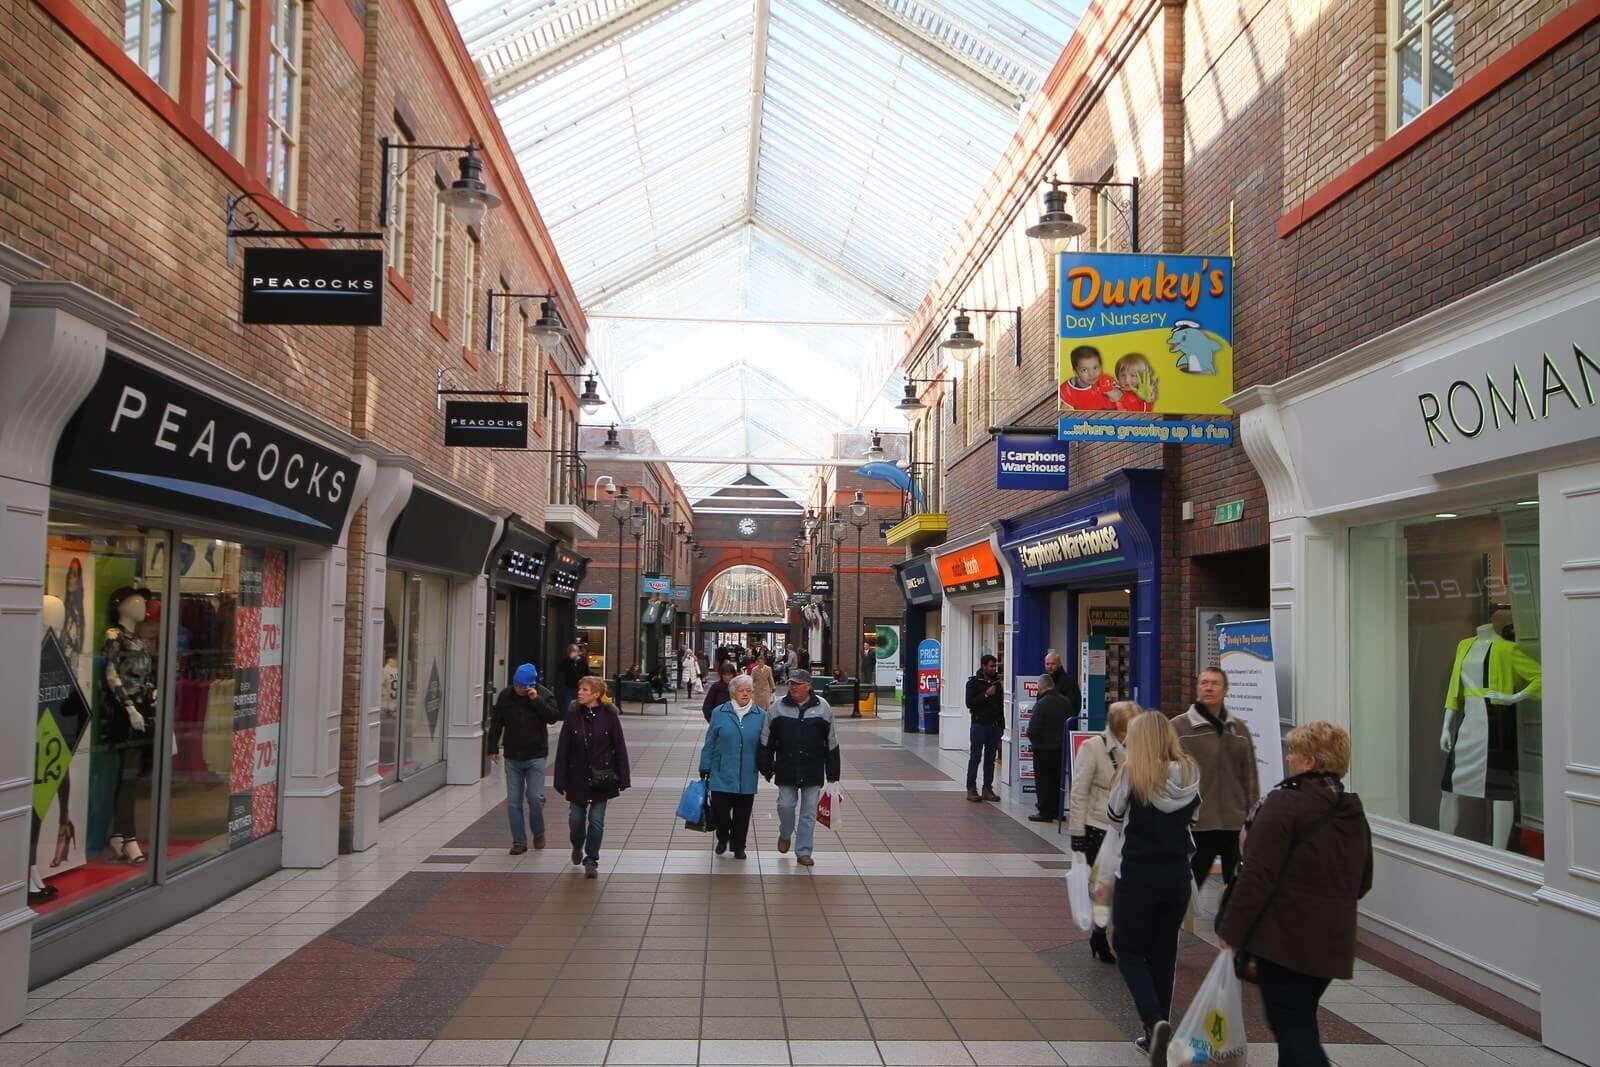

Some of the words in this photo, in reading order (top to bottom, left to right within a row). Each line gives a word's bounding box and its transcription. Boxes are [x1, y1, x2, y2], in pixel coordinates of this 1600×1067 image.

[252, 277, 374, 289] PEACOCKS
[1068, 260, 1224, 309] Dunky's
[1066, 315, 1095, 331] Day
[1101, 311, 1167, 326] Nursery
[451, 418, 523, 427] PEACOCKS
[1118, 424, 1169, 439] growing
[1172, 425, 1189, 440] up
[1192, 425, 1203, 438] is
[1206, 424, 1229, 438] fun
[110, 385, 346, 503] PEACOCKS
[1008, 451, 1065, 463] Carphone
[1001, 463, 1065, 473] Warehouse
[1022, 540, 1062, 571] Carphone
[1058, 525, 1119, 560] Warehouse
[920, 648, 940, 659] PRICE
[233, 692, 257, 707] FURTHER
[228, 814, 253, 833] FURTHER
